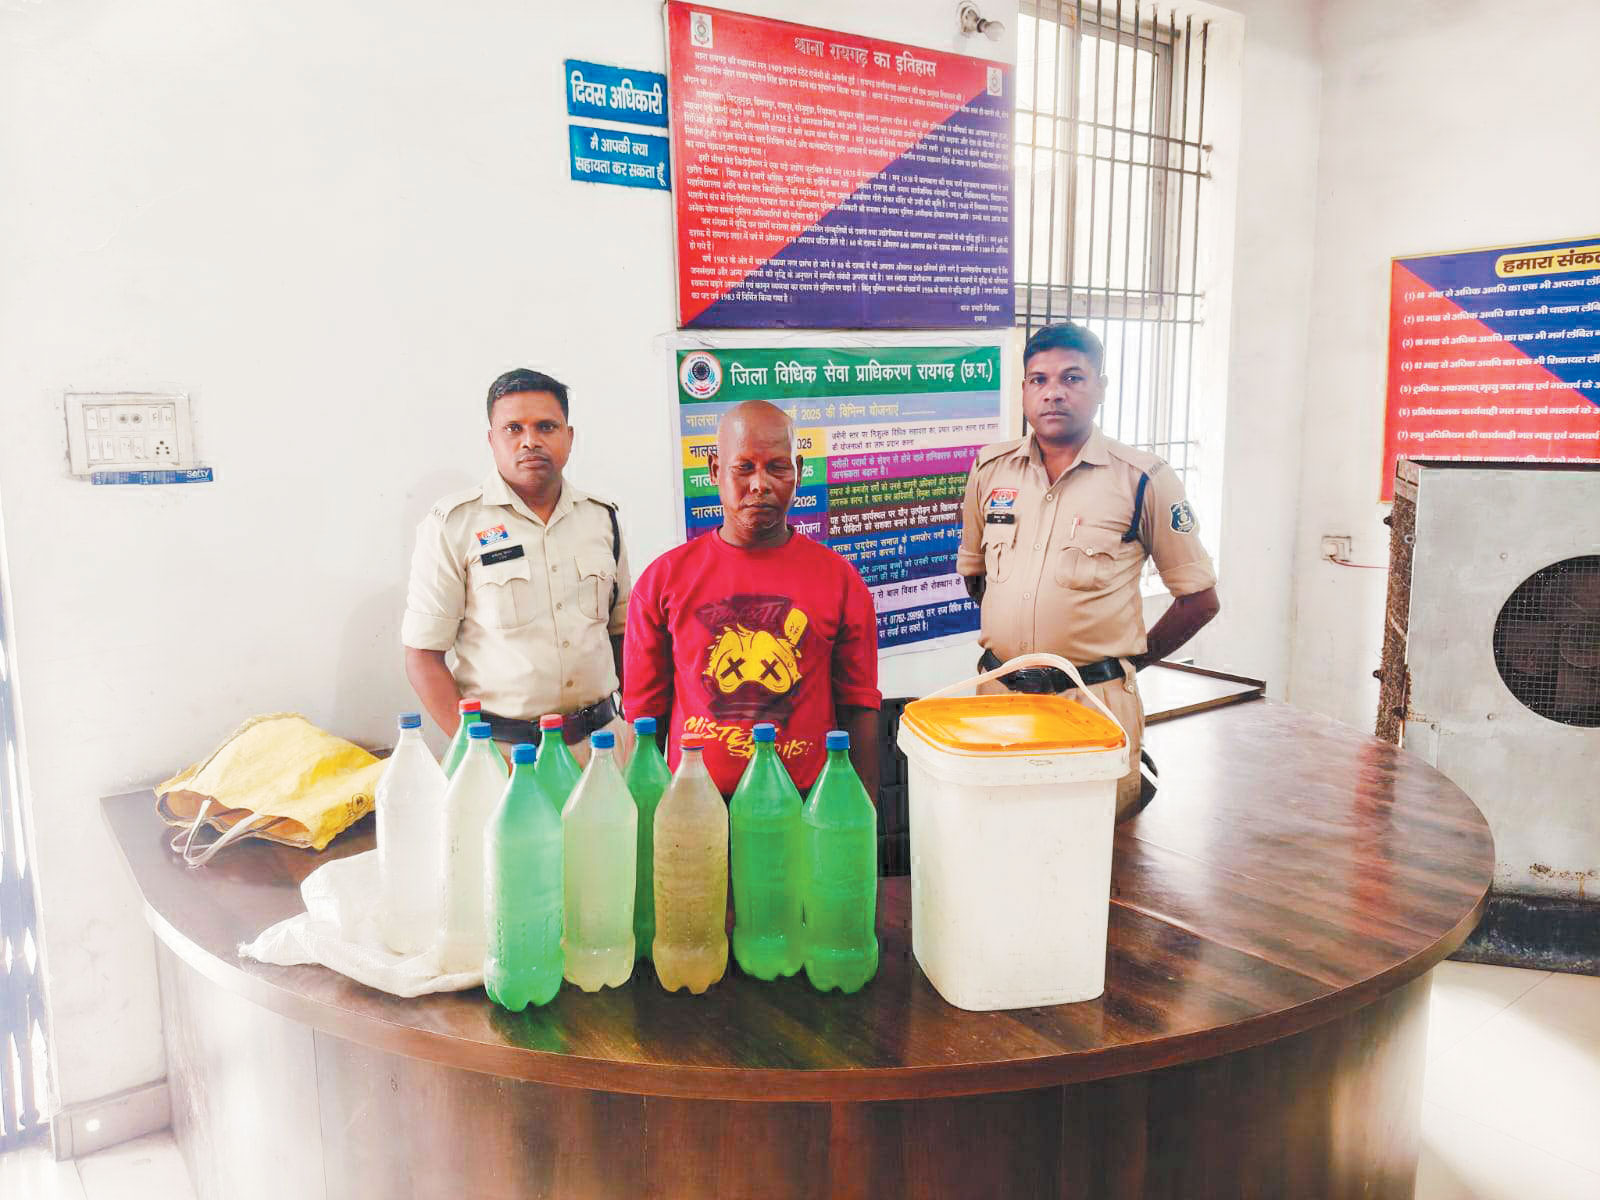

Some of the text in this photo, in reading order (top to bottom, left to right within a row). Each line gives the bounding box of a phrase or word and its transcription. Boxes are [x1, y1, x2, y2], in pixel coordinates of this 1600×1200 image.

[795, 37, 824, 58] थाना
[829, 43, 869, 69] रायगढ़
[873, 51, 890, 69] का
[896, 50, 936, 77] इतिहास
[571, 70, 607, 107] दिवस
[610, 78, 663, 115] अधिकारी
[601, 136, 630, 155] आपकी
[632, 142, 648, 157] क्या
[575, 157, 610, 174] सहायता
[612, 162, 627, 176] कर
[629, 163, 655, 179] सकता
[1503, 249, 1600, 274] हमारा संक
[1445, 287, 1453, 297] से
[1453, 285, 1481, 296] अधिक
[1482, 283, 1506, 294] अवधि
[1507, 284, 1520, 292] का
[1521, 282, 1538, 291] एक
[1539, 280, 1551, 289] भी
[1552, 279, 1584, 288] अपराध
[1442, 311, 1450, 320] से
[1451, 309, 1477, 320] अधिक
[1478, 307, 1504, 318] अवधि
[1504, 308, 1517, 316] का
[1518, 307, 1534, 315] एक
[1536, 304, 1548, 314] भी
[1441, 335, 1449, 344] से
[1450, 334, 1476, 344] अधिक
[1477, 333, 1502, 342] अवधि
[1535, 330, 1546, 340] भी
[1566, 328, 1593, 338] लंबित
[1449, 358, 1475, 367] अधिक
[1476, 357, 1500, 366] अवधि
[1516, 357, 1532, 365] एक
[1534, 355, 1545, 364] भी
[1546, 353, 1585, 363] शिकायत
[730, 359, 993, 386] जिला विधिक सेवा प्राधिकरण रायगढ़ (छ.ग.)
[1535, 381, 1549, 390] एवं
[1582, 380, 1592, 389] के
[685, 414, 717, 428] नालसा
[801, 409, 822, 420] 2025
[825, 404, 835, 417] की
[839, 404, 865, 418] विभिन्न
[1461, 406, 1497, 415] कार्यवाही
[1534, 405, 1547, 414] एवं
[1580, 405, 1591, 413] के
[1465, 430, 1478, 439] की
[1554, 430, 1566, 439] एवं
[689, 445, 719, 458] नालस
[797, 438, 812, 449] 025
[794, 495, 817, 508] 2025
[840, 511, 859, 523] योजना
[861, 508, 885, 521] कार्यस्थल
[887, 509, 895, 518] पर
[794, 520, 821, 535] योजना
[829, 524, 840, 535] और
[864, 520, 871, 530] को
[879, 537, 898, 546] समाज
[910, 530, 931, 542] कमजोर
[879, 548, 895, 556] करना
[877, 588, 883, 599] से
[901, 582, 918, 595] विवाह
[920, 581, 928, 591] की
[955, 576, 961, 585] के
